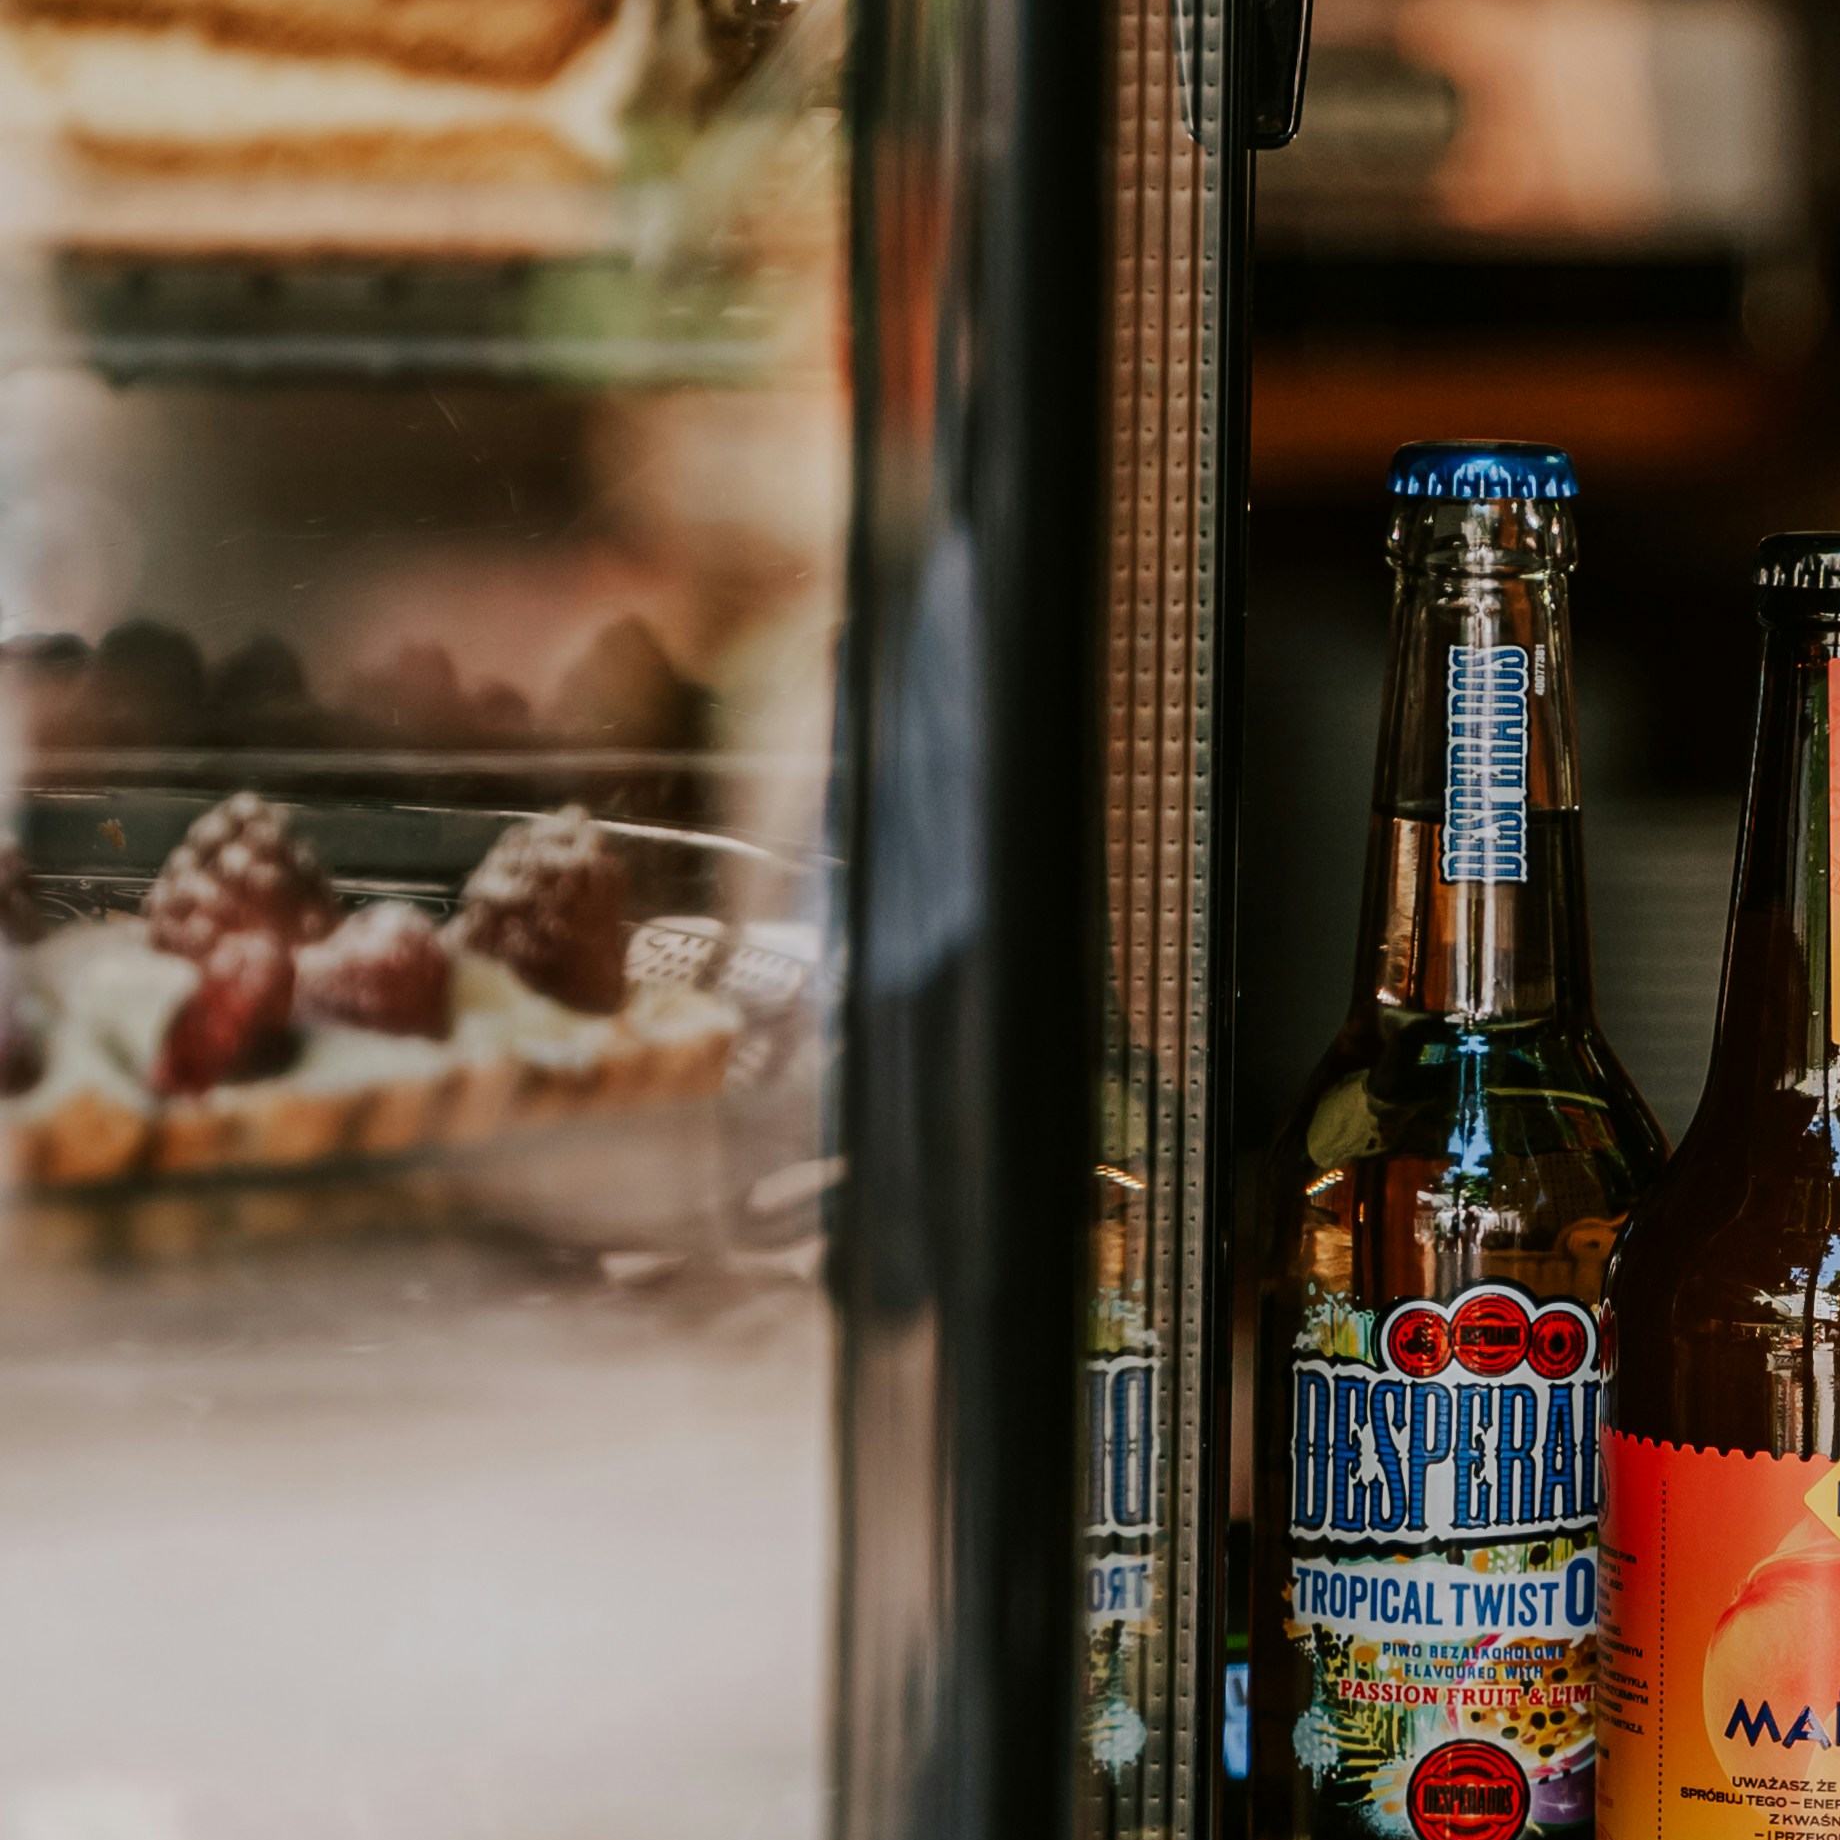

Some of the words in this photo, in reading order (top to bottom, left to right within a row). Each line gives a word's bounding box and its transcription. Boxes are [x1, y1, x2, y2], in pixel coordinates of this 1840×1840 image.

[1445, 645, 1527, 882] DESPERADOS
[1296, 1566, 1443, 1626] TROPICAL
[1450, 1582, 1559, 1628] TWIST
[1382, 1642, 1422, 1659] PIWO
[1429, 1645, 1565, 1661] BEZALKOHOLOWE
[1404, 1663, 1497, 1680] FLAVOURED
[1504, 1665, 1544, 1680] WITH
[1338, 1678, 1440, 1705] PASSION
[1446, 1687, 1522, 1707] FRUIT
[1528, 1688, 1544, 1707] &
[1551, 1684, 1598, 1705] LIM
[1732, 1776, 1813, 1793] UWAŻASZ,
[1817, 1779, 1837, 1793] ŻE
[1423, 1783, 1514, 1816] DESPERADOS
[1680, 1787, 1744, 1806] SPRÓBUJ
[1746, 1795, 1788, 1807] TEGO
[1769, 1814, 1780, 1825] Z
